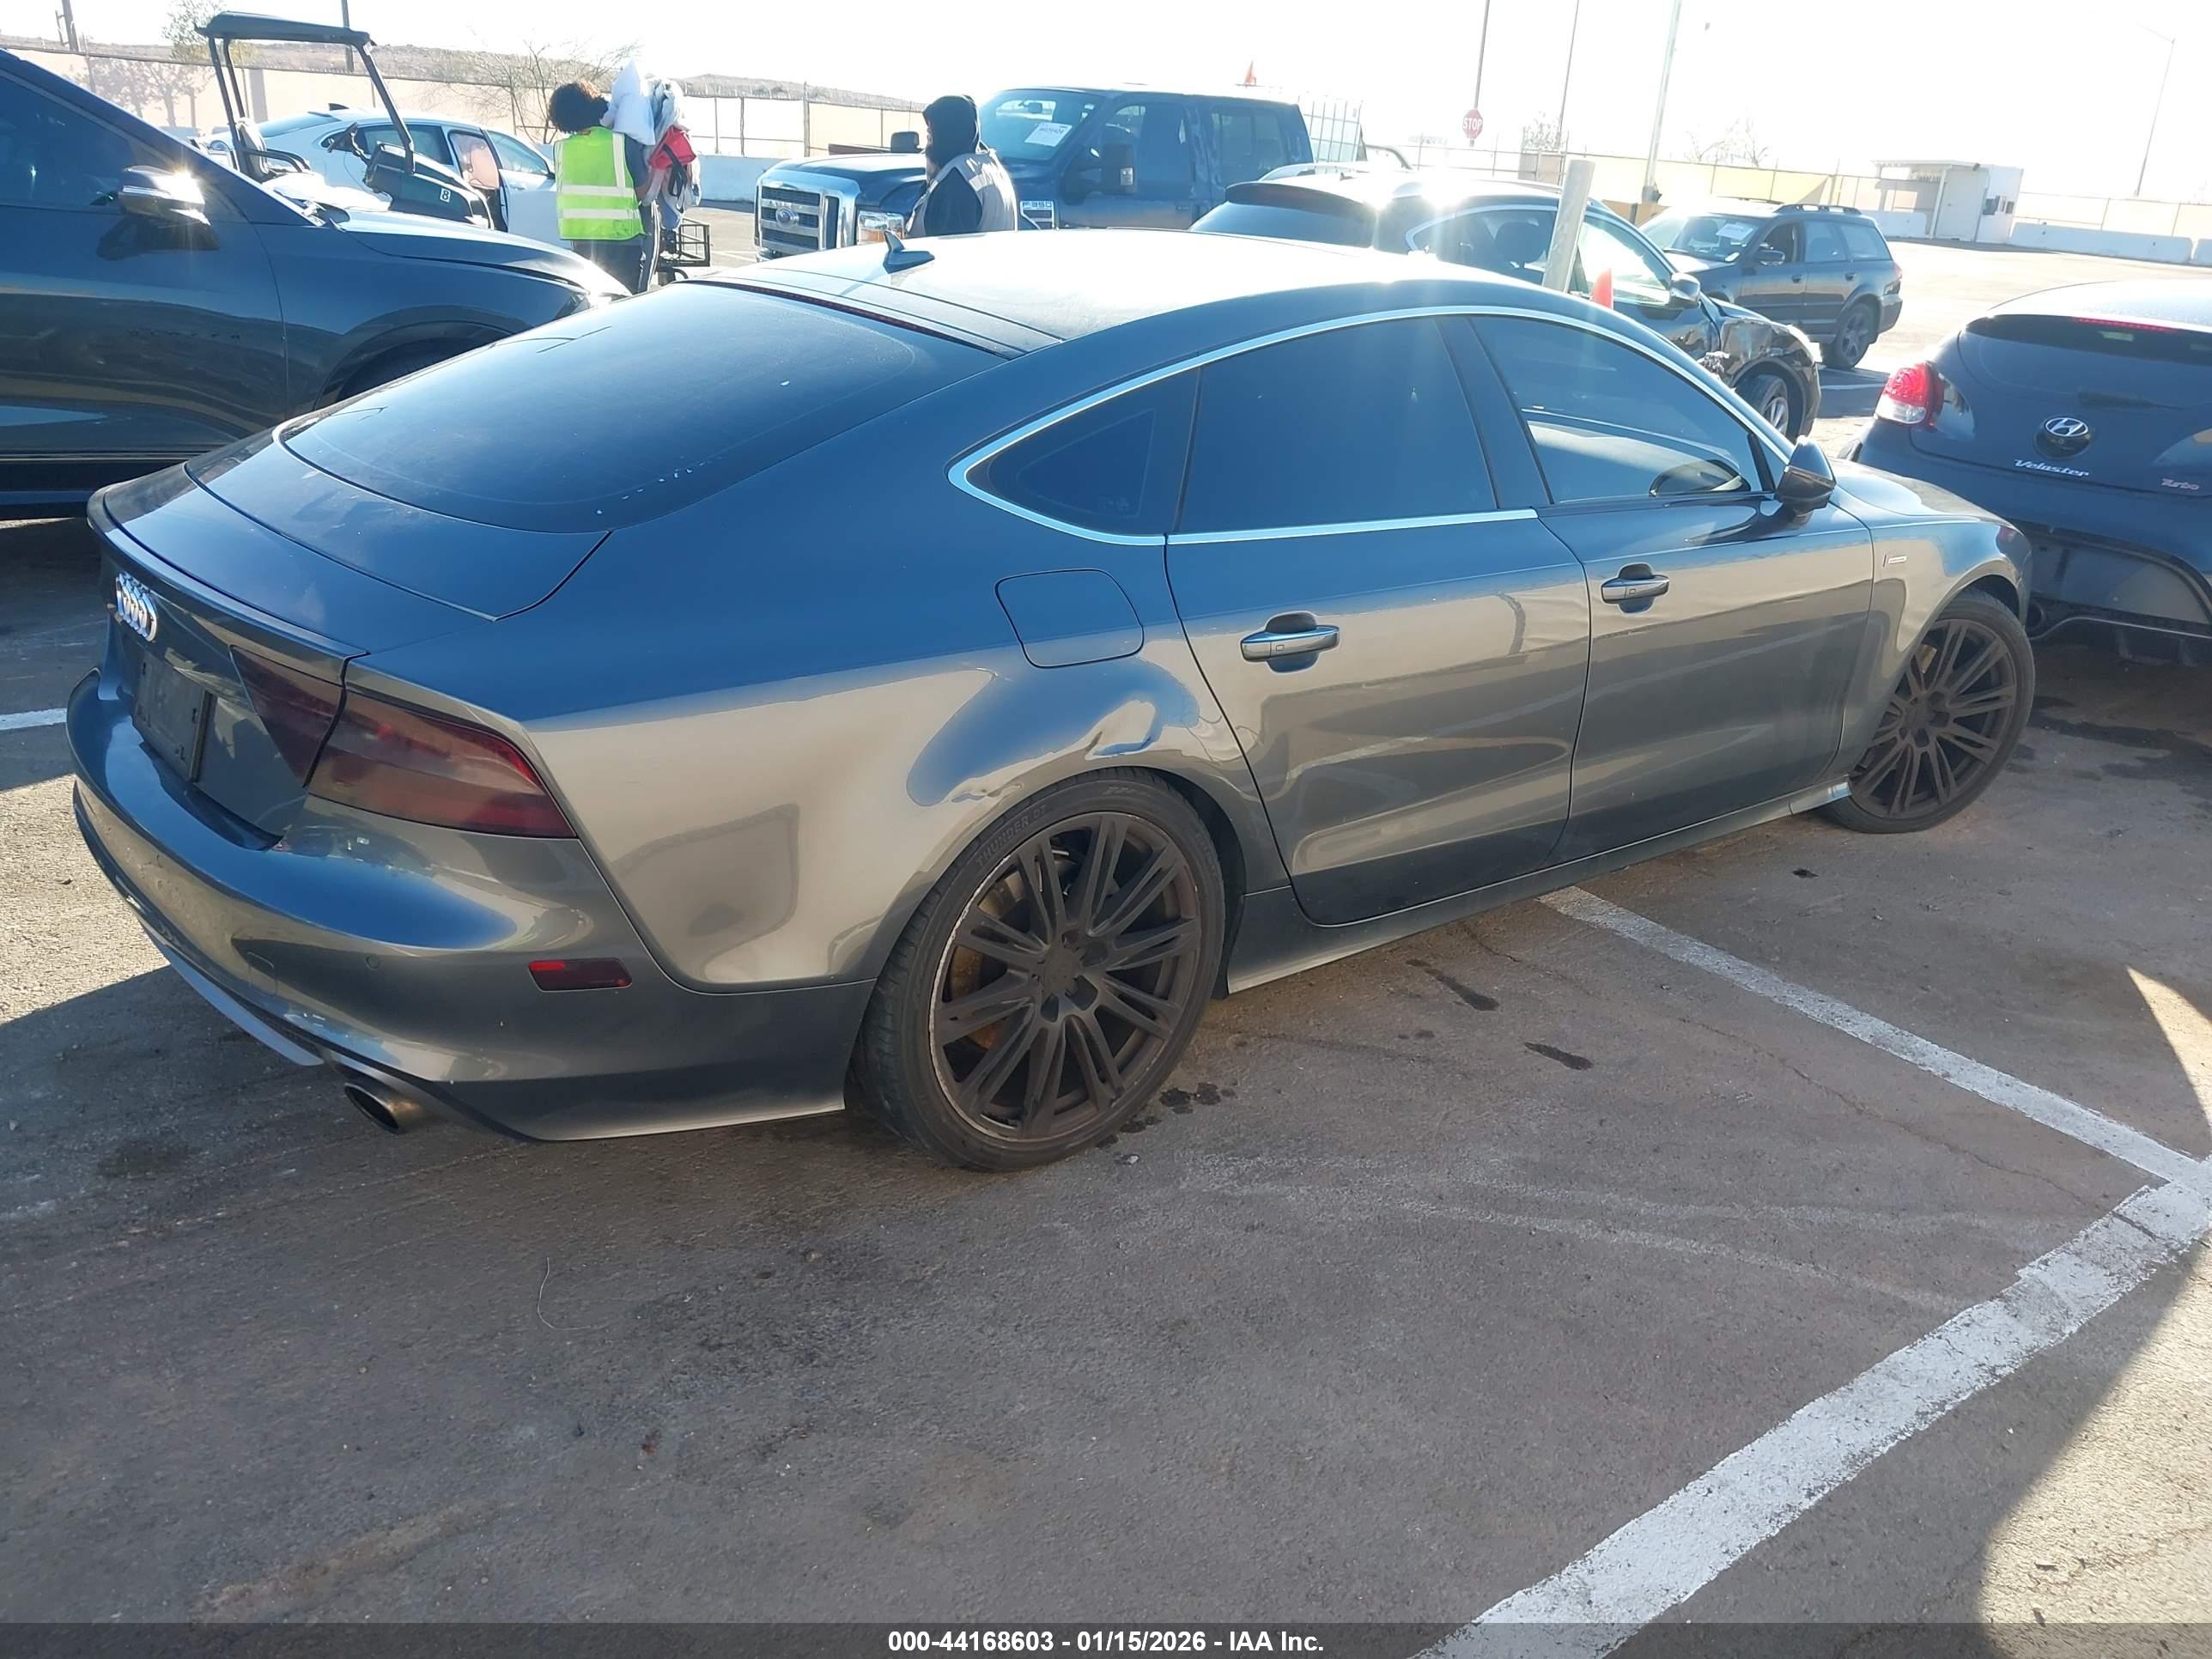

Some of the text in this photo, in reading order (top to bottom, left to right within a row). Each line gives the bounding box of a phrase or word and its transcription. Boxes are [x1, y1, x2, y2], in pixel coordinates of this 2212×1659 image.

[1463, 117, 1482, 131] STOP
[441, 190, 449, 200] 8
[2014, 459, 2089, 477] Veloster
[2161, 478, 2200, 491] Turbo
[975, 816, 1029, 866] THUNDER
